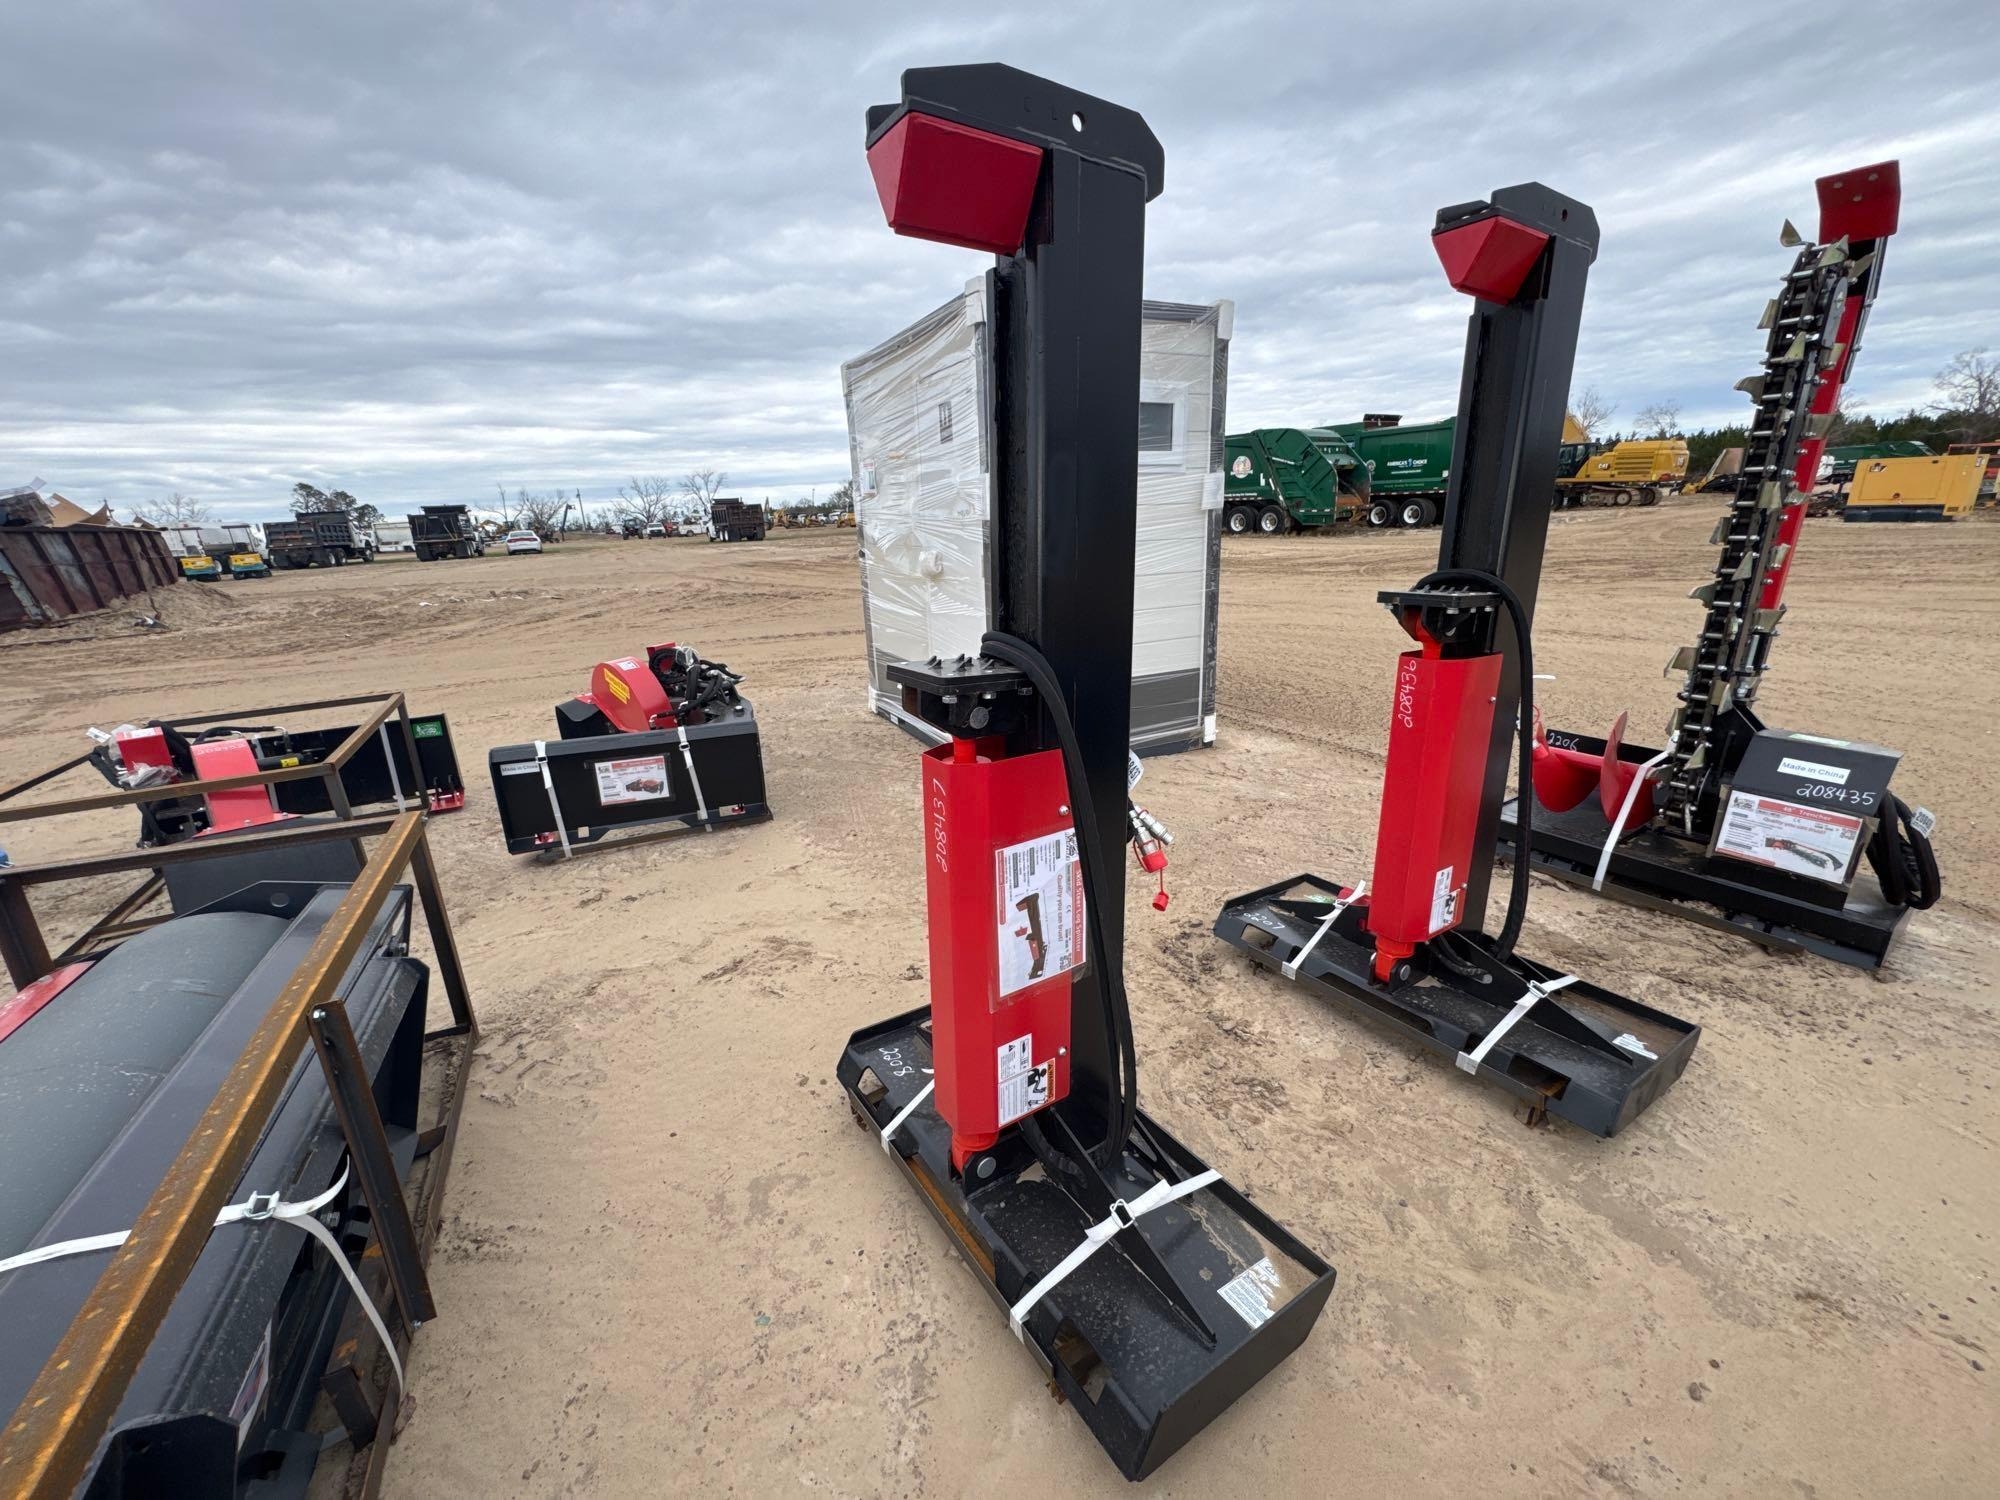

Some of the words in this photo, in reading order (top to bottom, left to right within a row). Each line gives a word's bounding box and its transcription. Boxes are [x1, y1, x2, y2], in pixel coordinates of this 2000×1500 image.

[1398, 660, 1417, 728] 208436
[1548, 732, 1579, 752] 2206
[1782, 762, 1806, 771] Made
[1817, 769, 1845, 779] China
[1796, 783, 1877, 805] 208435
[933, 778, 948, 873] 208437
[1800, 808, 1833, 821] Trencher
[1056, 874, 1064, 898] Quality
[1074, 909, 1082, 925] Log
[1074, 926, 1082, 952] Splitter
[879, 1047, 915, 1076] 2208
